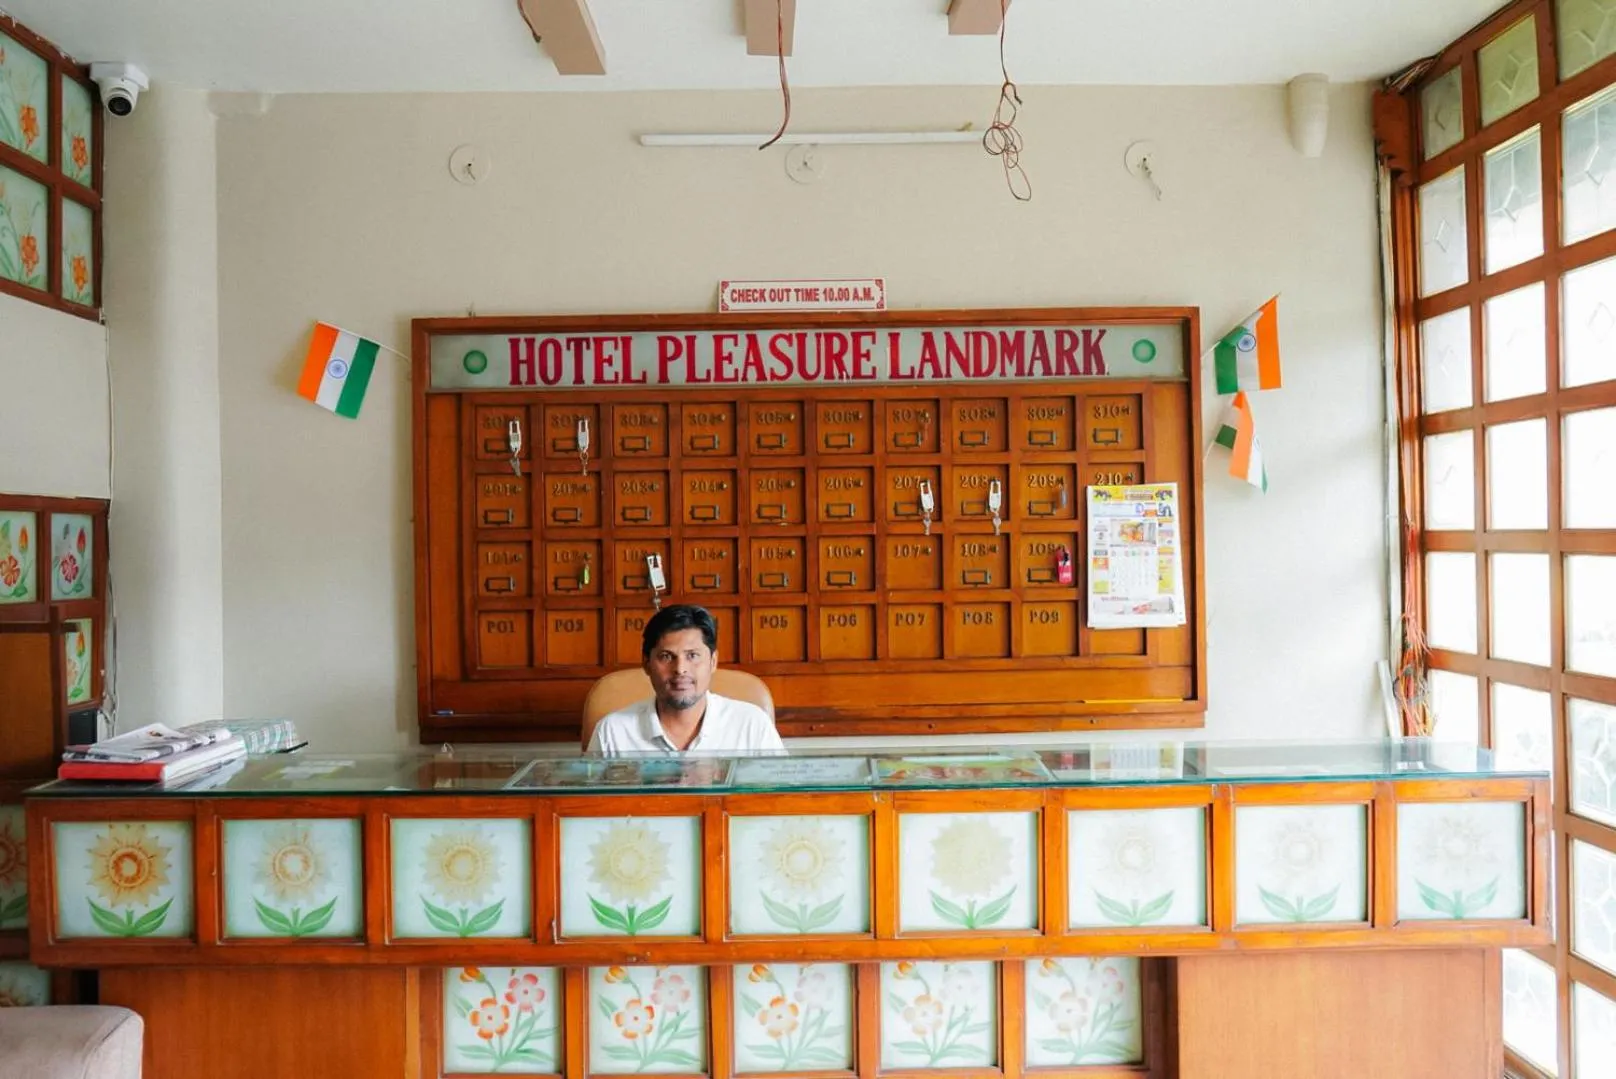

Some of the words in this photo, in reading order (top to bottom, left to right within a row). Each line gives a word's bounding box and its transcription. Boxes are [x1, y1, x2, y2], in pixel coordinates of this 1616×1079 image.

[730, 289, 767, 303] CHECK
[769, 289, 791, 302] OUT
[794, 288, 819, 302] TIME
[823, 288, 849, 301] 10.00
[852, 287, 874, 301] A.M.
[508, 336, 647, 386] HOTEL
[656, 331, 876, 385] PLEASURE
[888, 329, 1109, 380] LANDMARK
[825, 476, 853, 490] 206
[894, 475, 921, 489] 207
[960, 474, 989, 488] 208
[1027, 473, 1056, 487] 209
[1095, 471, 1123, 486] 210
[826, 545, 852, 558] 106
